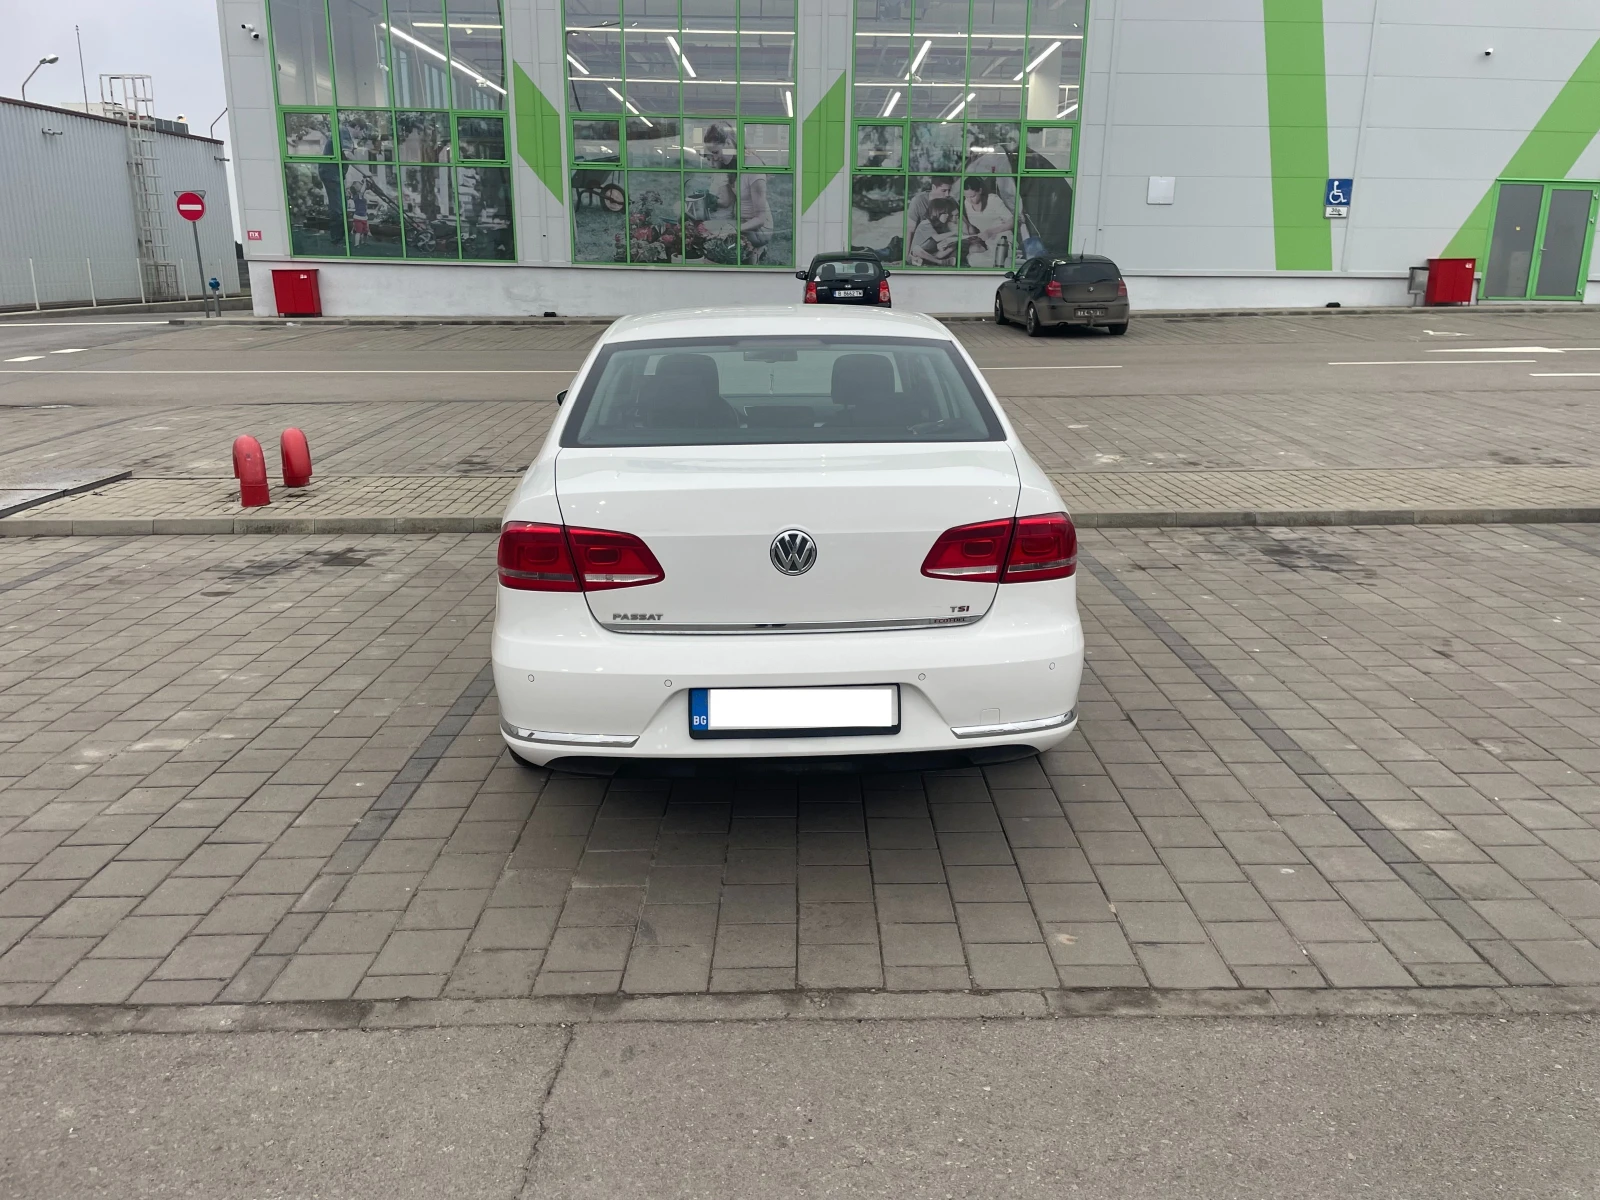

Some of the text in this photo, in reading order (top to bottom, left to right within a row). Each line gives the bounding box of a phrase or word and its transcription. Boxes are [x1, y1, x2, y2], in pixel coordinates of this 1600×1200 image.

[949, 605, 970, 613] TSI
[612, 613, 664, 621] PASSAT
[693, 715, 707, 726] BG
